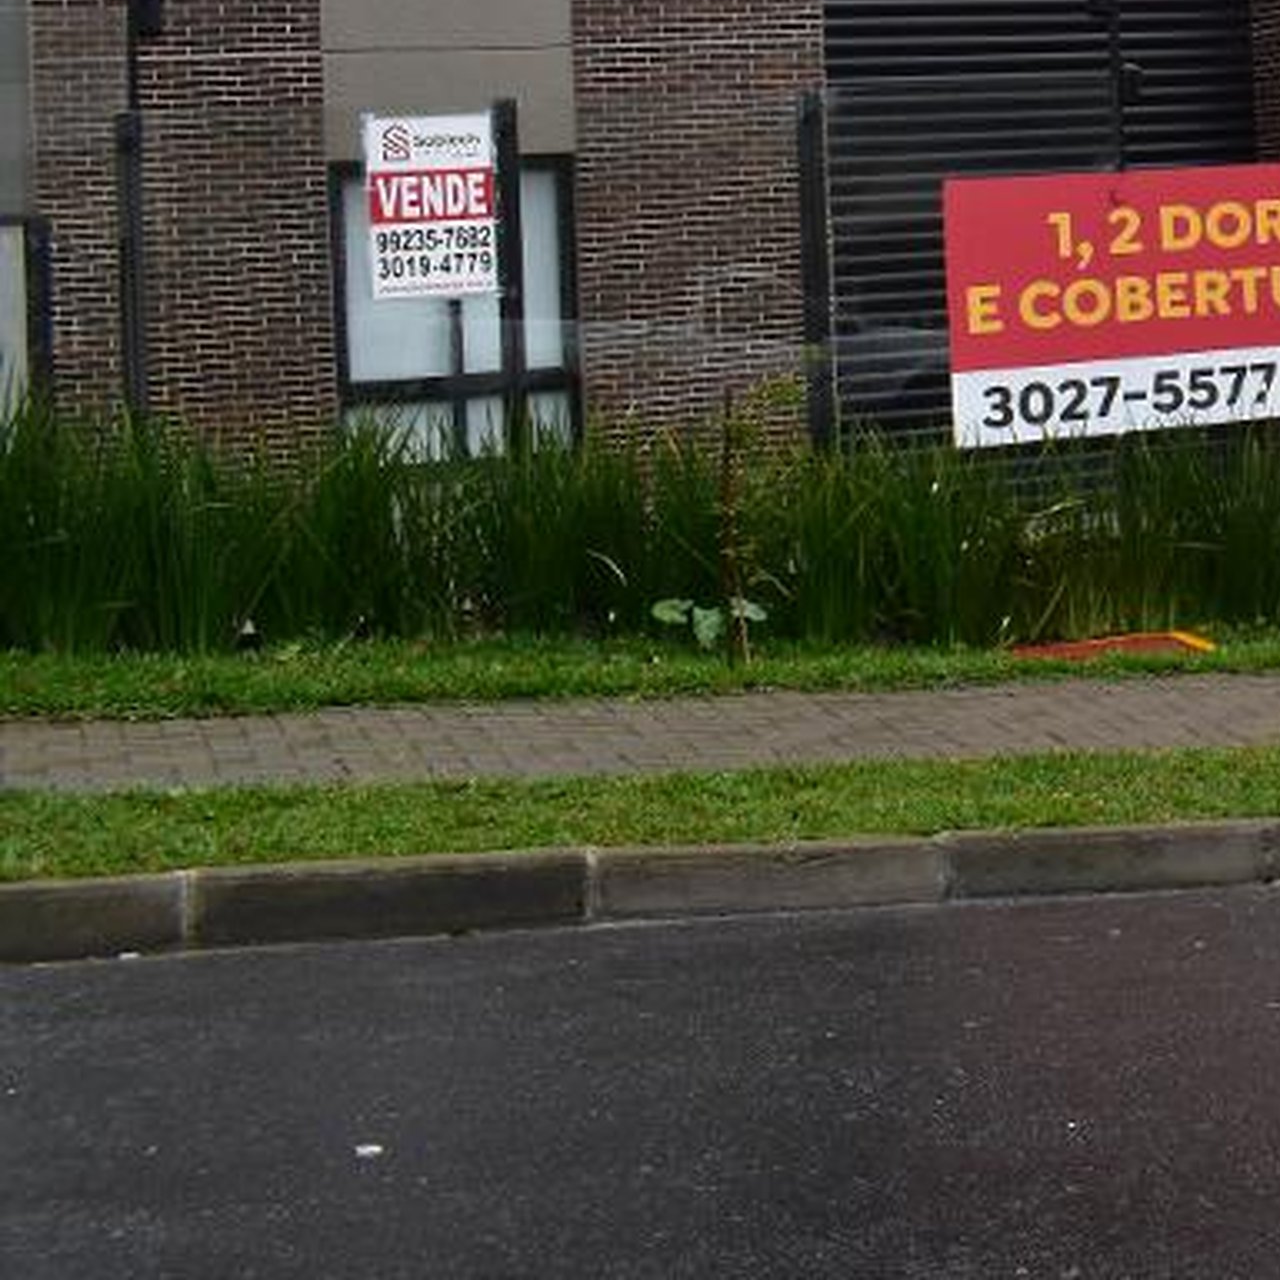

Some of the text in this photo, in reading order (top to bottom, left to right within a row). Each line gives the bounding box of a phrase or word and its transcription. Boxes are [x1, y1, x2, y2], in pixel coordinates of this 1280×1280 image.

[376, 173, 488, 219] VENDE
[1107, 205, 1144, 256] 2
[965, 284, 1005, 336] E
[982, 361, 1278, 430] 3027-5577
